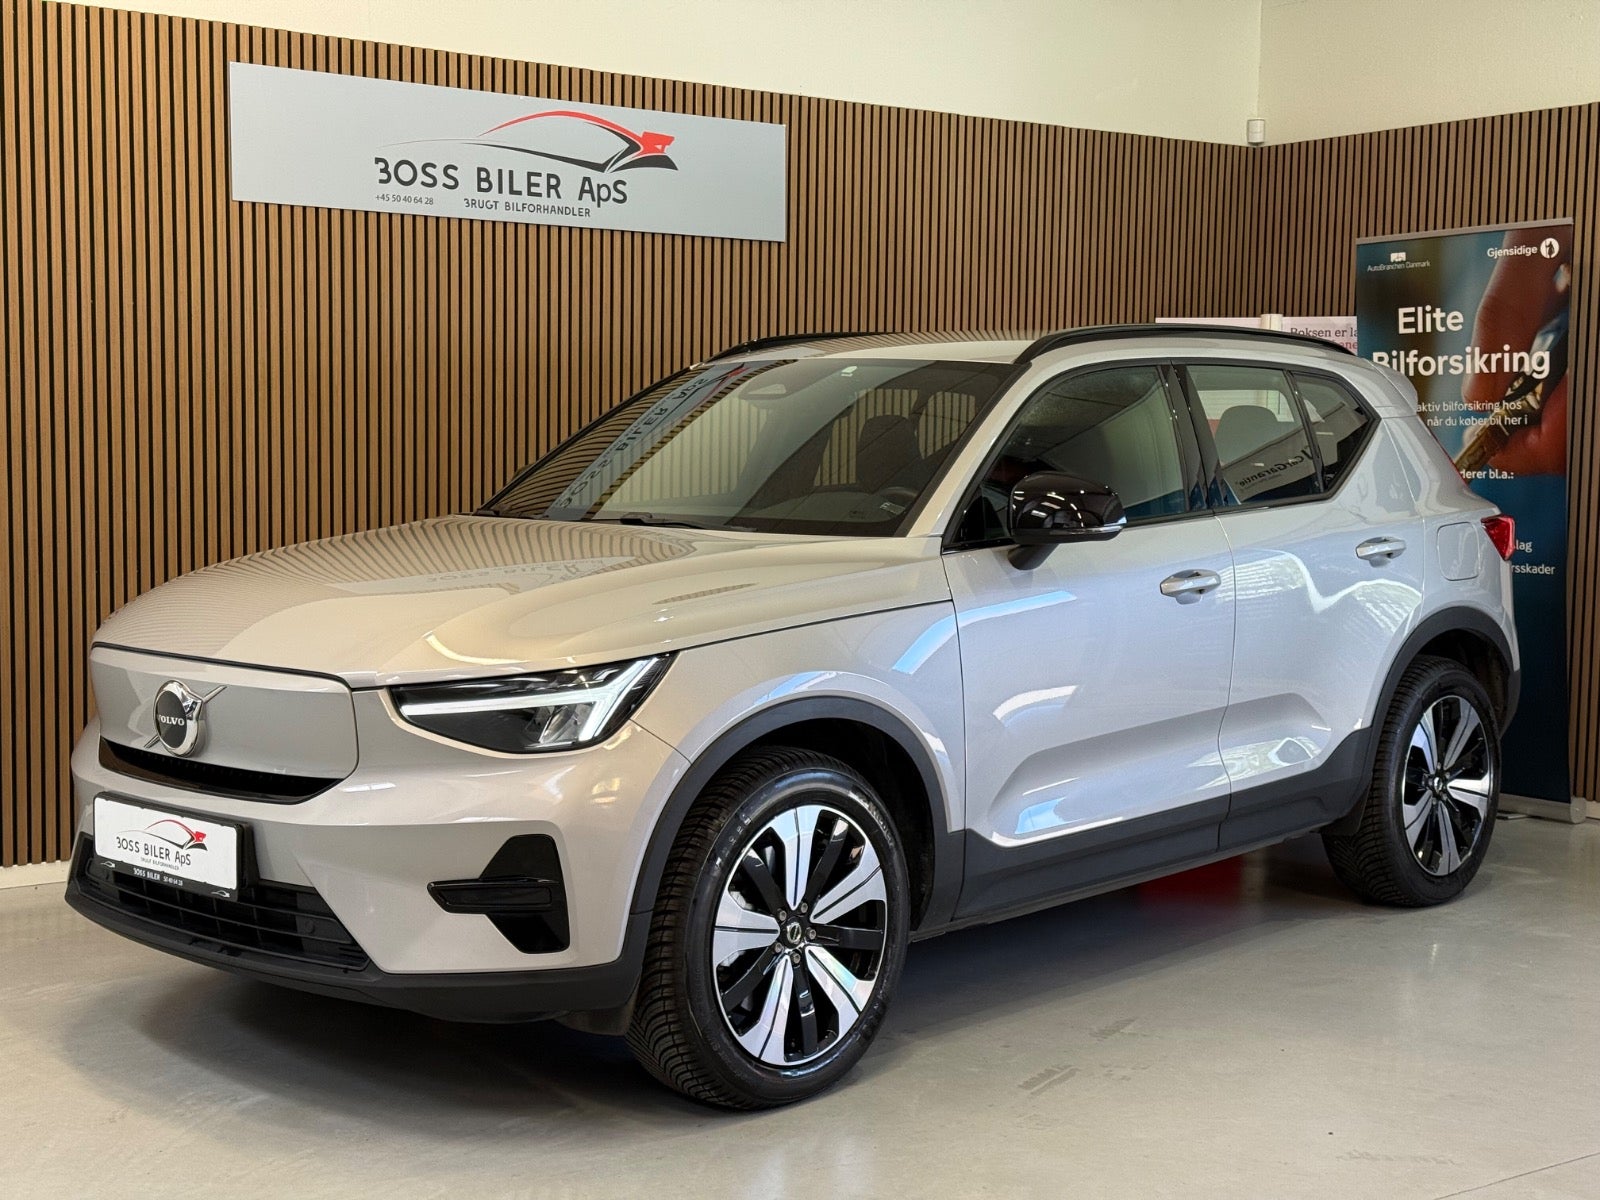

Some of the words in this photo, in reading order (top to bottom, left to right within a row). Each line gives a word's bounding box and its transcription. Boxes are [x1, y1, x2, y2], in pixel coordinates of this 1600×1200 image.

[476, 166, 562, 200] BILER
[577, 176, 628, 208] ApS
[375, 193, 390, 202] +45
[391, 195, 402, 203] 50
[402, 196, 413, 204] 40
[424, 197, 434, 205] 28
[504, 201, 591, 218] BILFORHANDLER
[1486, 245, 1538, 259] Gjensidige
[1367, 263, 1405, 272] AutoBranchen
[1405, 260, 1431, 268] Danmark
[1398, 305, 1464, 334] Elite
[1334, 329, 1348, 338] er
[1372, 344, 1550, 380] Bilforsikring
[1442, 400, 1500, 412] bilforsikring
[1502, 400, 1522, 410] hos
[1427, 416, 1442, 426] når
[1444, 416, 1457, 426] du
[1459, 416, 1487, 426] køber
[1489, 416, 1501, 425] bil
[1504, 416, 1521, 425] her
[1524, 415, 1528, 425] i
[1488, 468, 1514, 479] bl.a.:
[1513, 539, 1533, 553] lag
[1511, 563, 1555, 575] rsskader
[159, 715, 185, 726] OLVO
[143, 843, 170, 861] BILER
[174, 851, 191, 867] ApS
[146, 871, 160, 881] BILER
